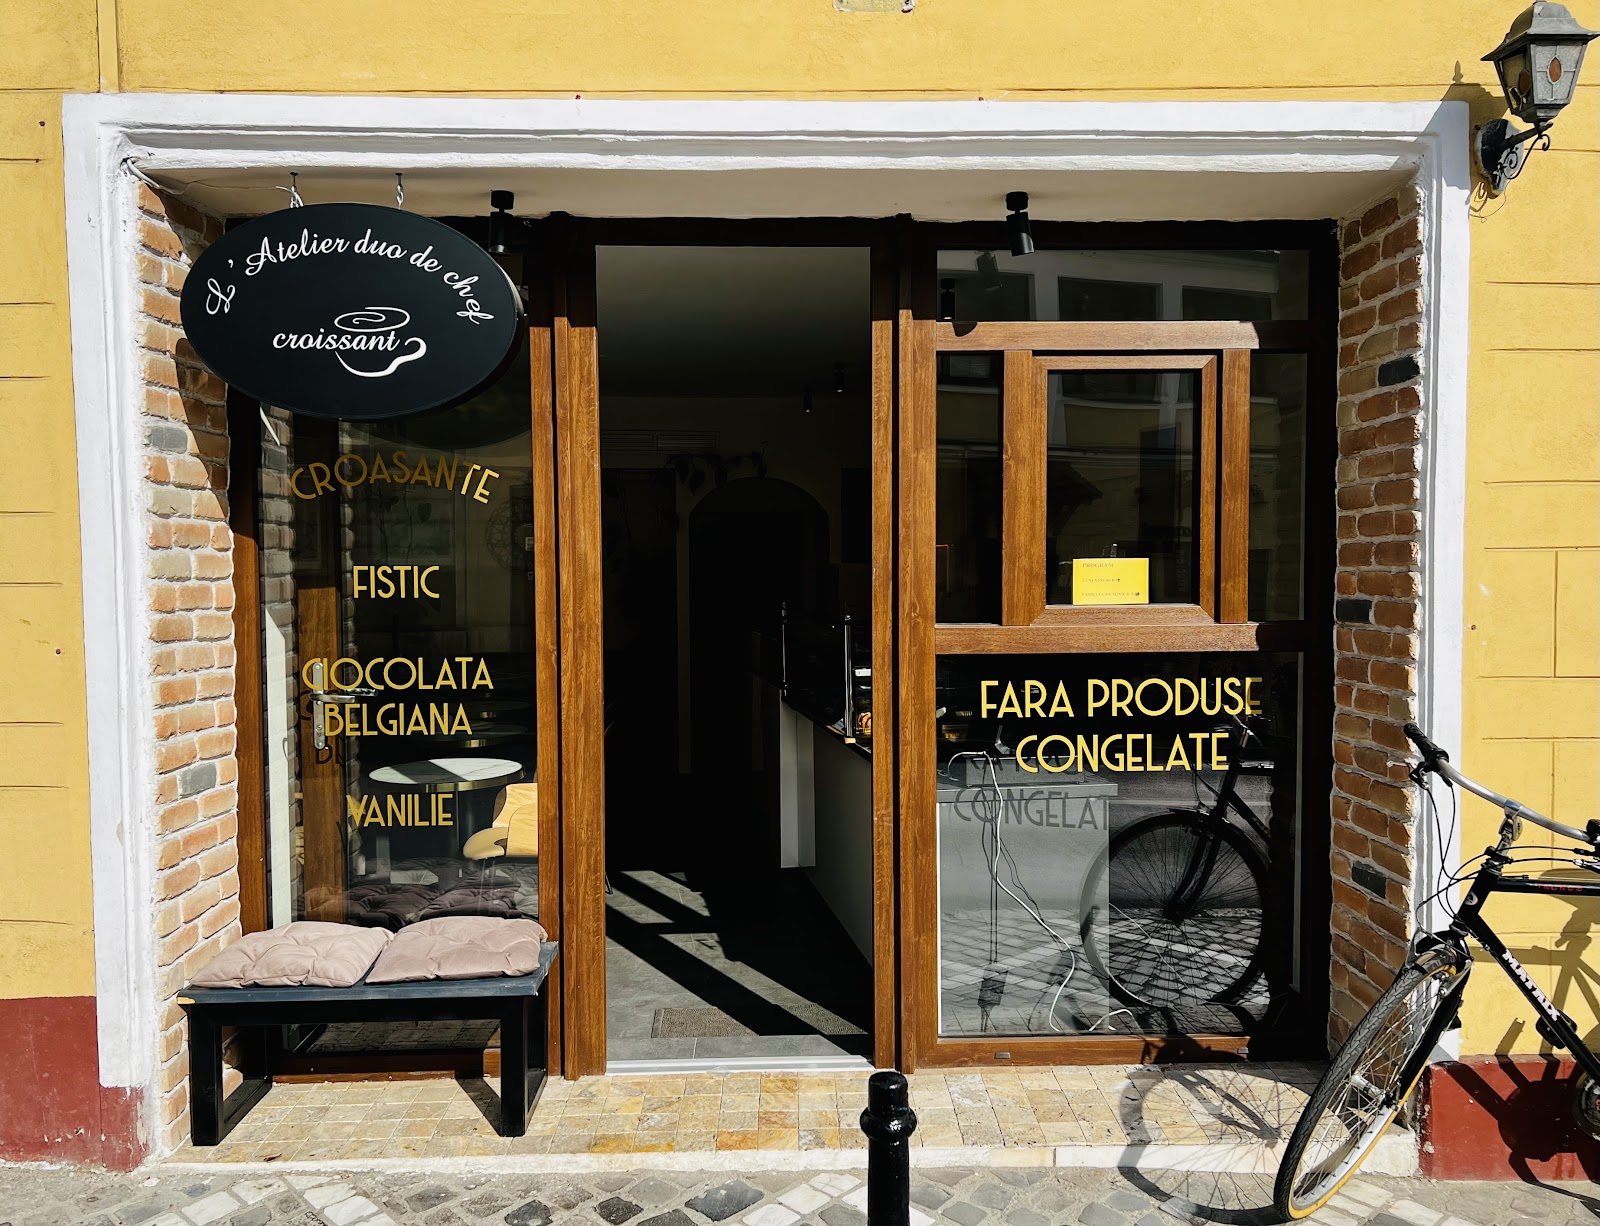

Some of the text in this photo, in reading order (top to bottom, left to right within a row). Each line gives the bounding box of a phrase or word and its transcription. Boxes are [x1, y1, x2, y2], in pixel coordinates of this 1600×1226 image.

[354, 228, 408, 259] duo
[409, 245, 442, 274] de
[443, 266, 495, 325] chef
[272, 328, 401, 352] croissant
[290, 450, 500, 505] CROASANTE
[352, 565, 440, 599] FISTIC
[301, 657, 495, 691] CIOCOLATA
[980, 677, 1263, 719] FARA PRODUSE
[324, 702, 473, 737] BELGIANA
[1015, 732, 1229, 773] CONGELATE
[346, 793, 454, 827] VANILIE
[1501, 948, 1561, 1022] MATRIX
